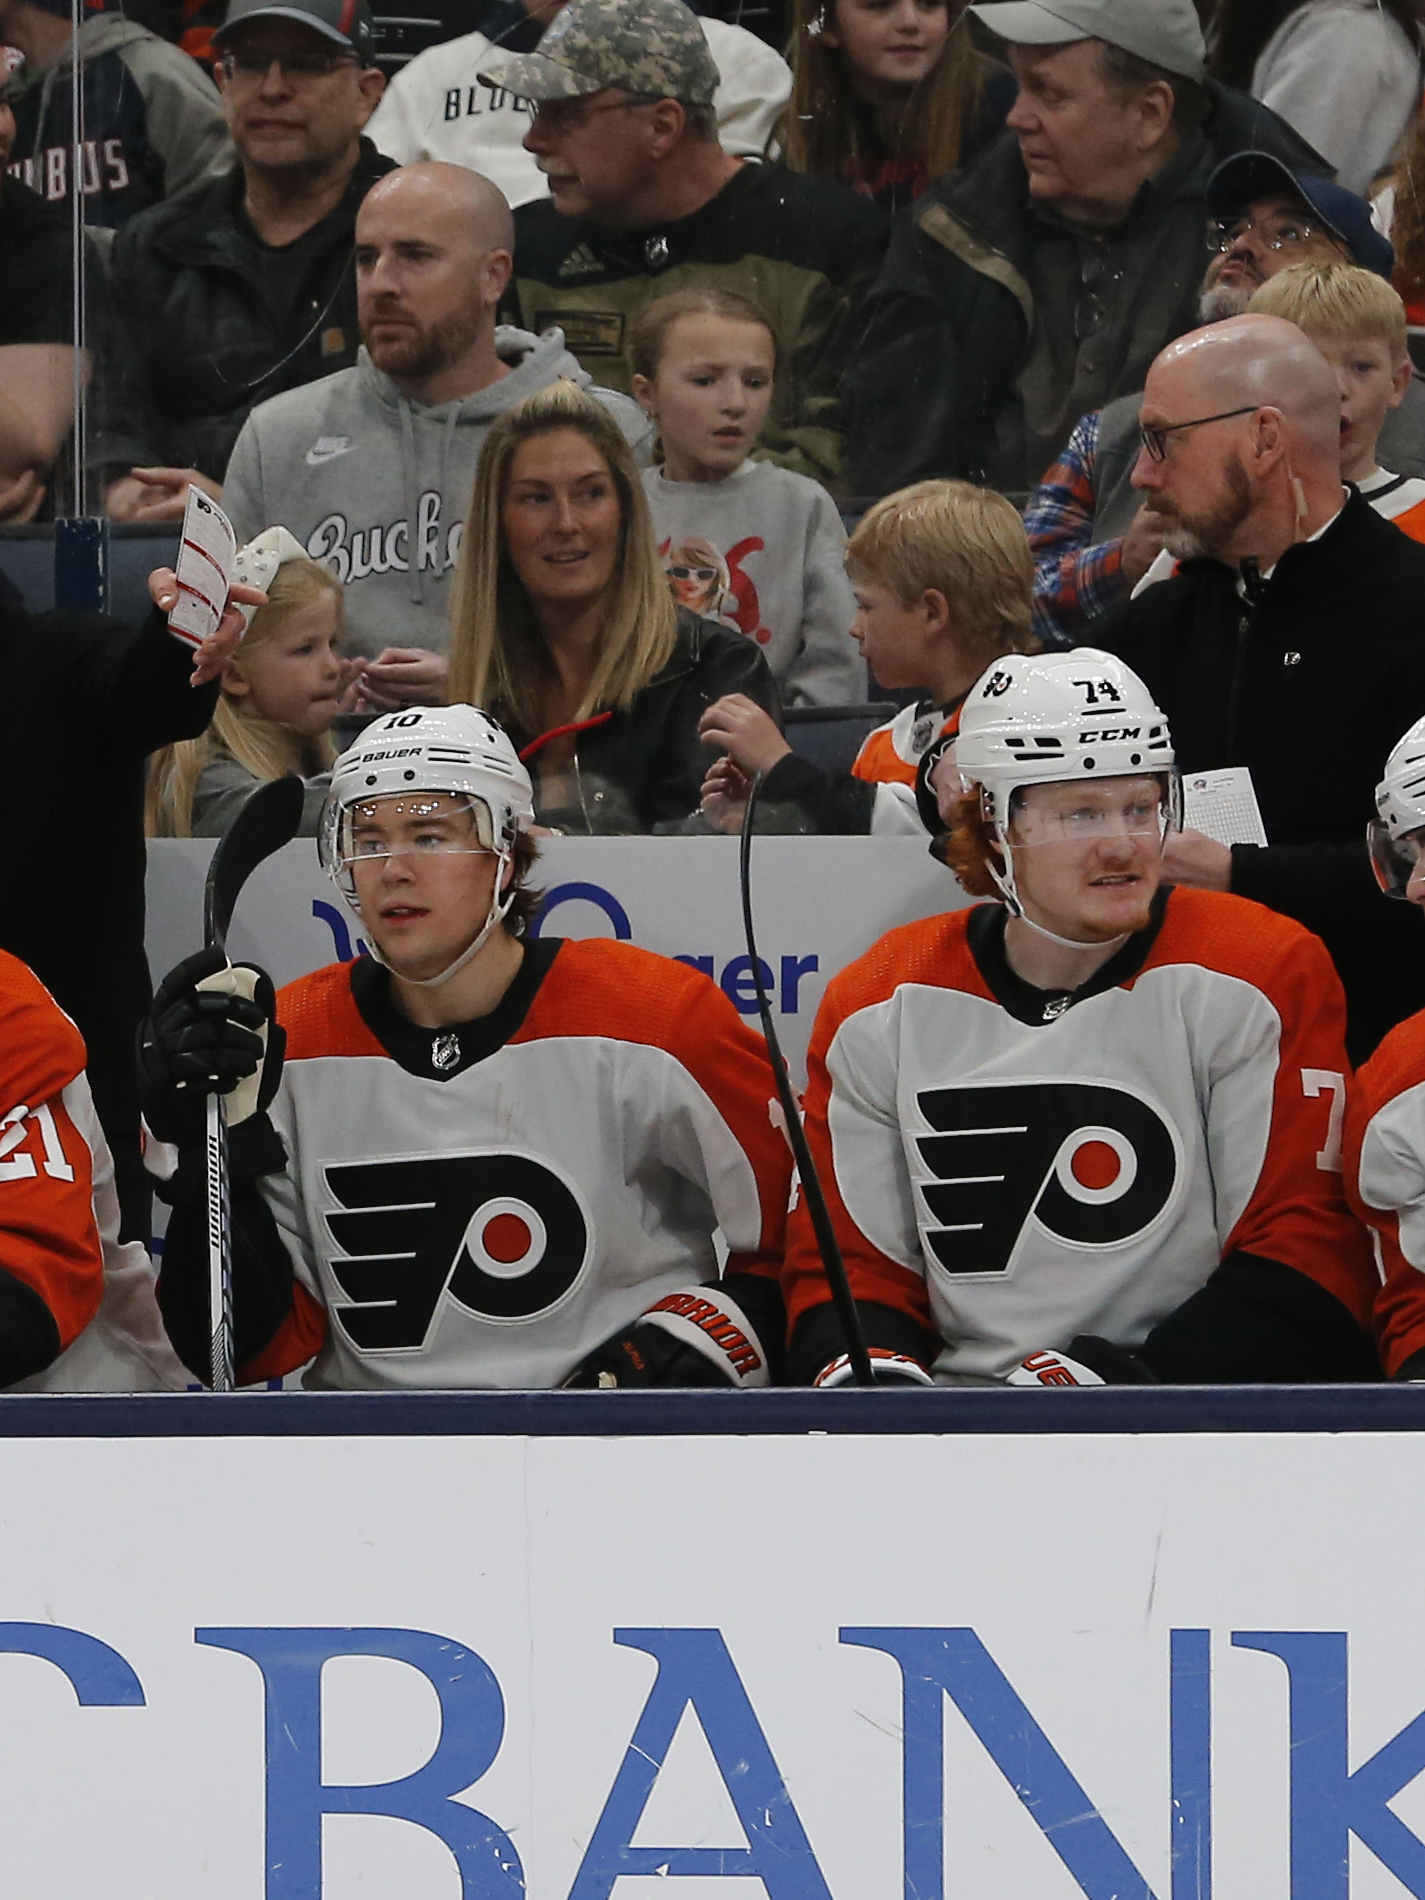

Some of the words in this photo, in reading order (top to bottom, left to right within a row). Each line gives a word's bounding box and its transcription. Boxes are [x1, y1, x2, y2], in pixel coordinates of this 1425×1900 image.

[1072, 679, 1122, 704] 74
[383, 713, 423, 731] 10
[1078, 726, 1142, 744] CCM
[362, 746, 423, 763] BAUER
[208, 1134, 221, 1250] WARRIOR
[639, 1292, 763, 1380] RRIOR
